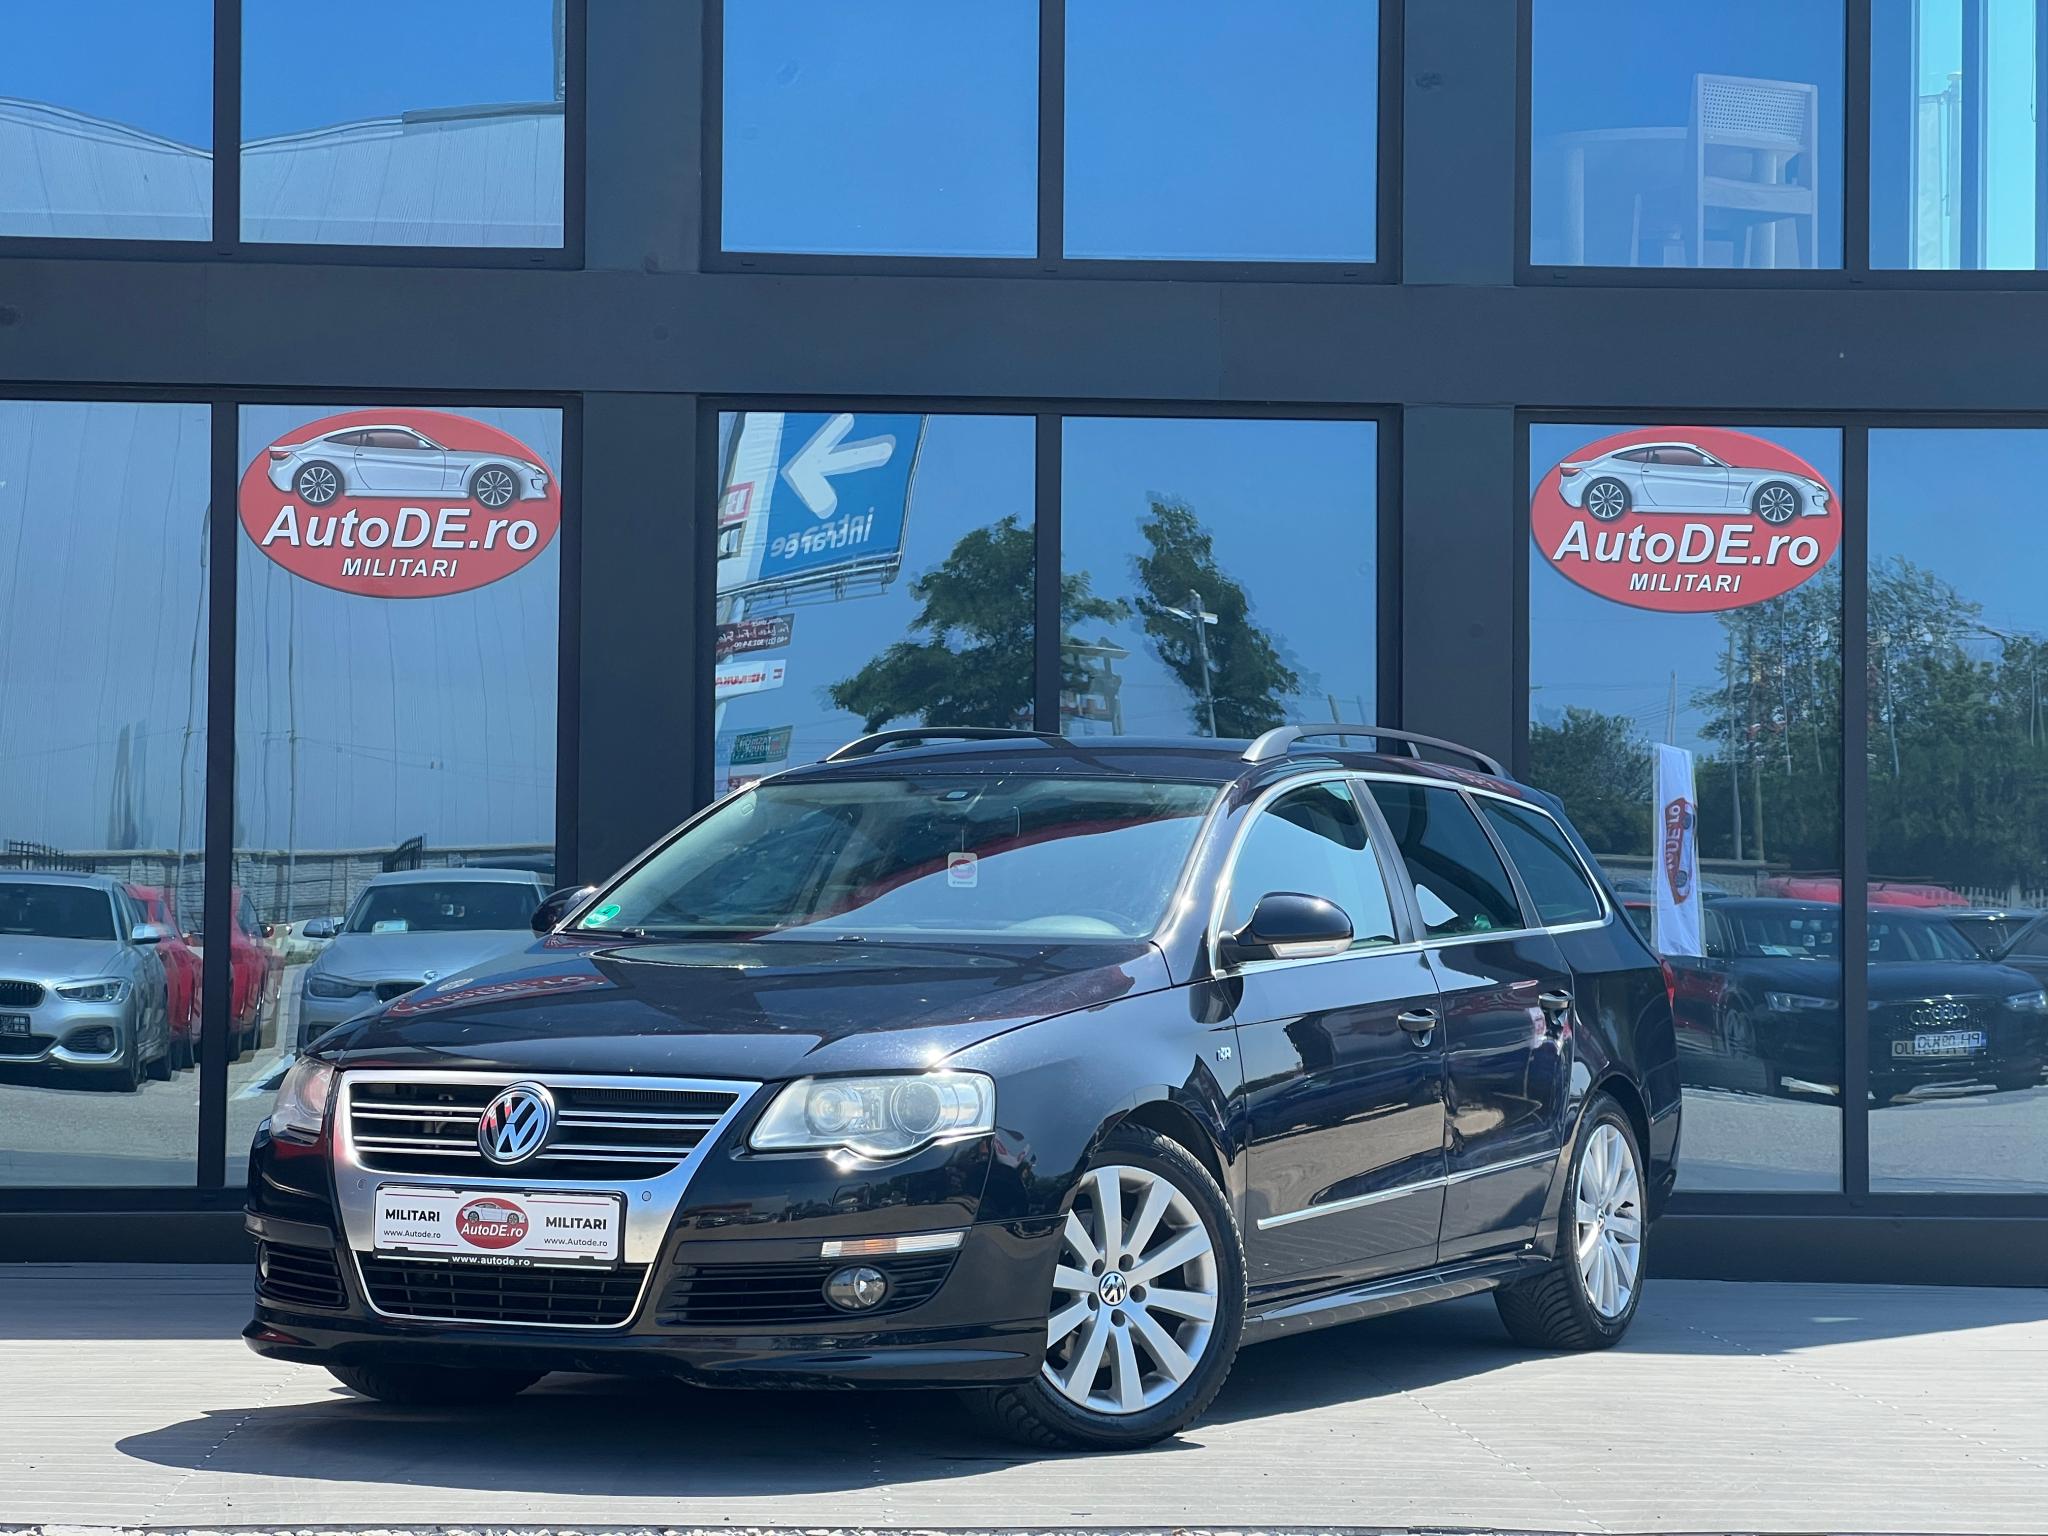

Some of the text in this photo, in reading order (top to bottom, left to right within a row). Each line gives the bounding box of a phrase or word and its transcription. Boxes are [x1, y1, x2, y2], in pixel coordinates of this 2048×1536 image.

[262, 505, 539, 550] AutoDE.ro
[1553, 521, 1819, 567] AutoDE.ro
[342, 558, 458, 577] MILITARI
[1629, 573, 1741, 592] MILITARI
[385, 1208, 440, 1222] MILITARI
[461, 1222, 524, 1238] AutoDE.ro
[545, 1216, 607, 1230] MILITARI
[383, 1228, 441, 1239] www.Autode.ro
[543, 1236, 608, 1247] www.Autode.ro
[452, 1255, 530, 1266] www.autode.ro
